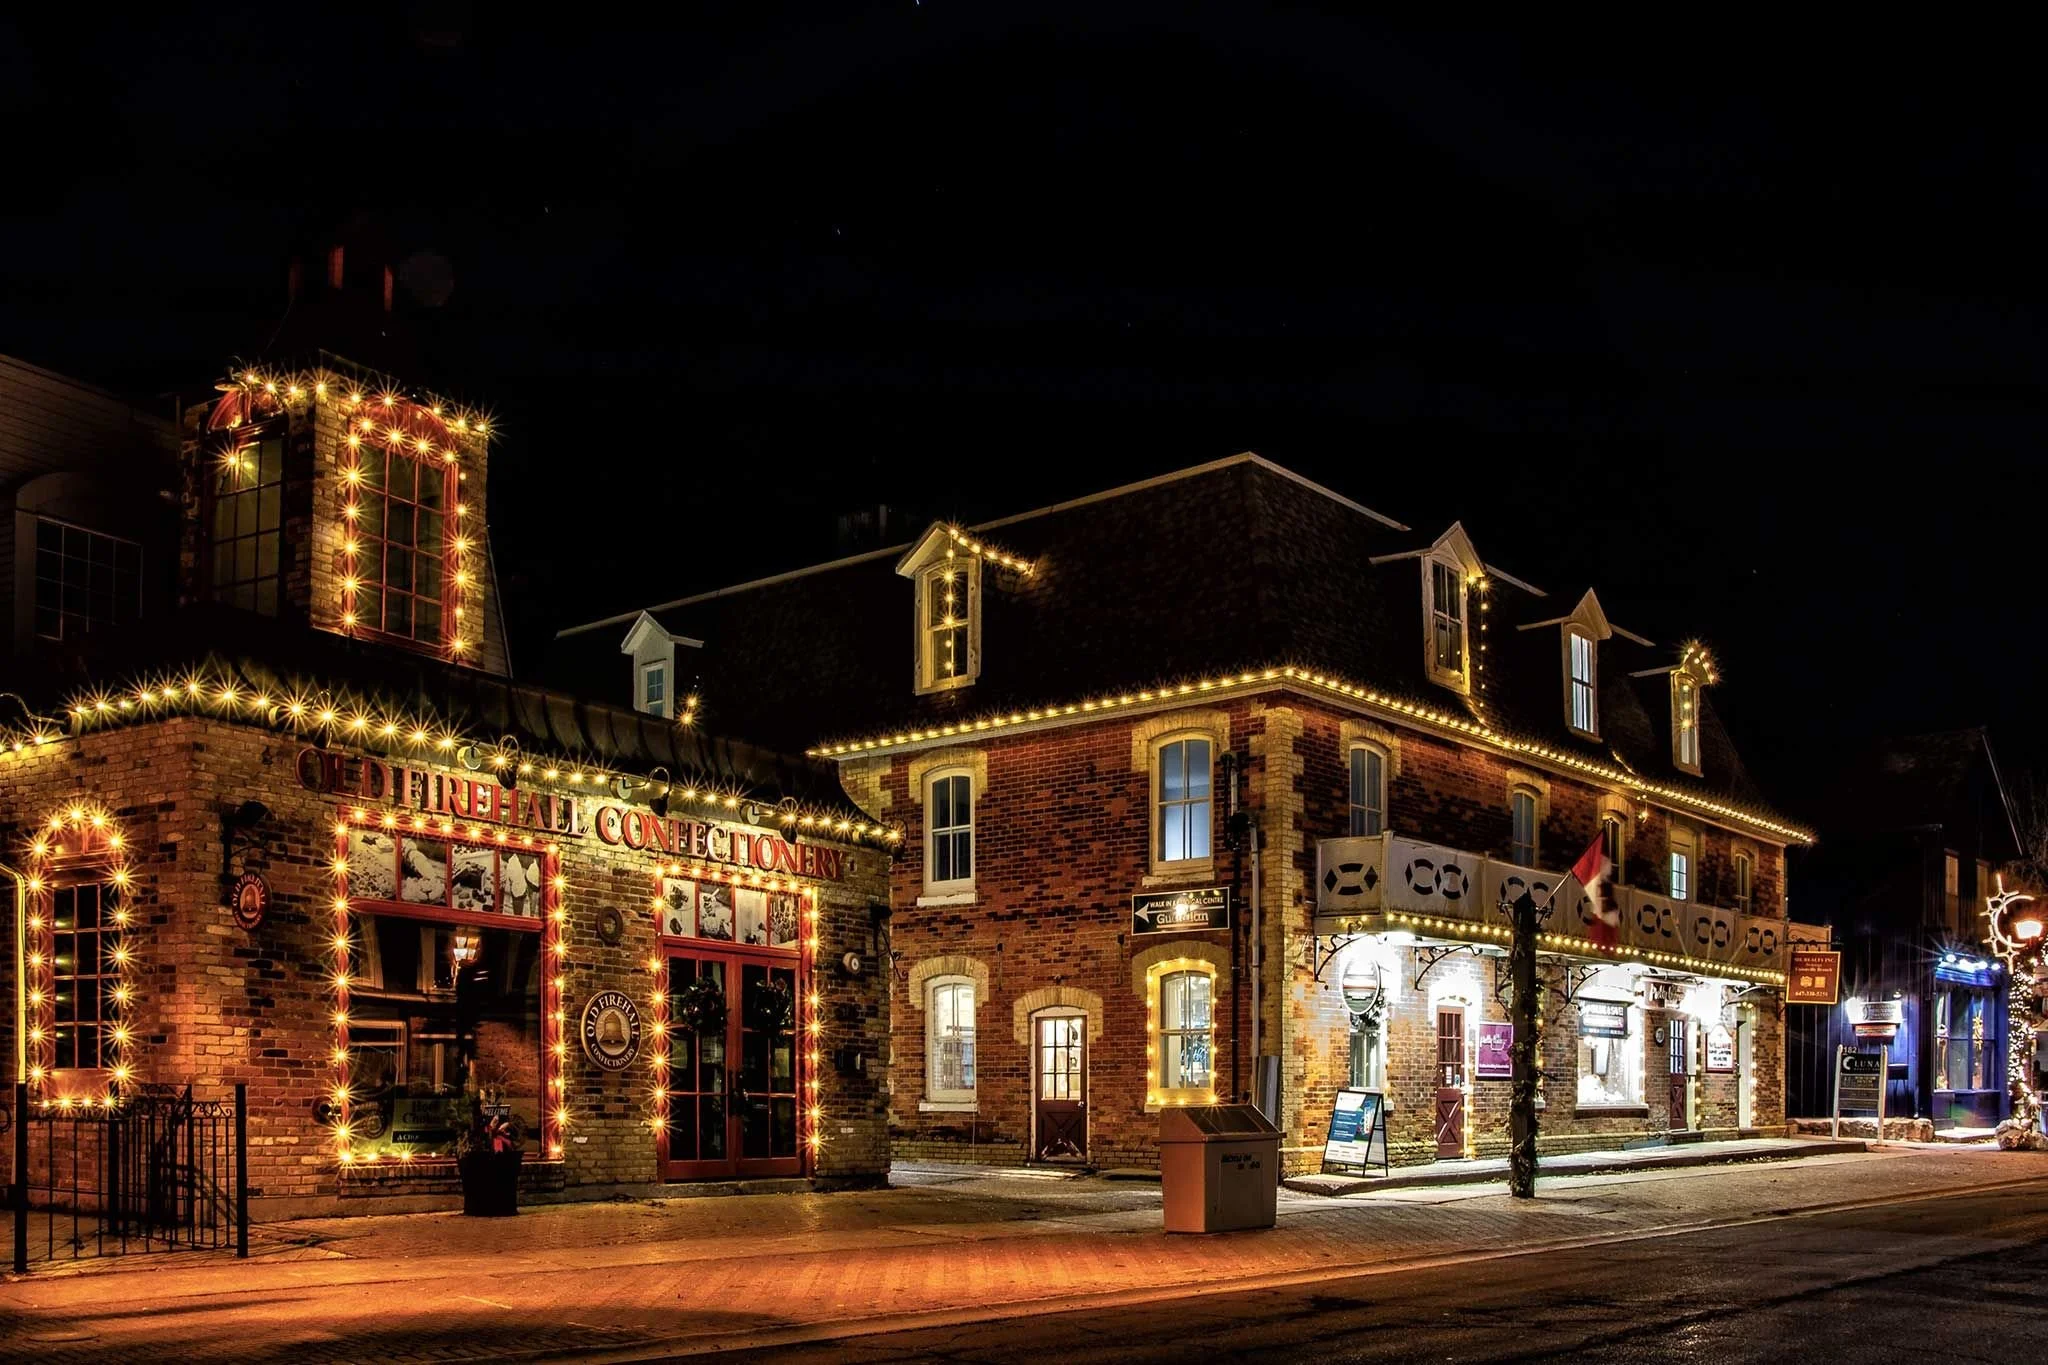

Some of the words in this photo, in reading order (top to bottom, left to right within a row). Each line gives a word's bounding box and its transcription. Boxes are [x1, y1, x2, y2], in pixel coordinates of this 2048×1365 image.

[295, 747, 402, 801] OLD
[398, 766, 589, 837] FIREHALL
[595, 806, 845, 879] CONFECTIONERY
[1202, 896, 1224, 904] CENTRE
[586, 1006, 600, 1038] OLD
[598, 994, 640, 1040] FIREHALL
[591, 1043, 636, 1067] CONFECTIONERY
[1843, 1047, 1857, 1055] 182
[1854, 1060, 1880, 1068] LUNA
[483, 1107, 509, 1117] WELCOME
